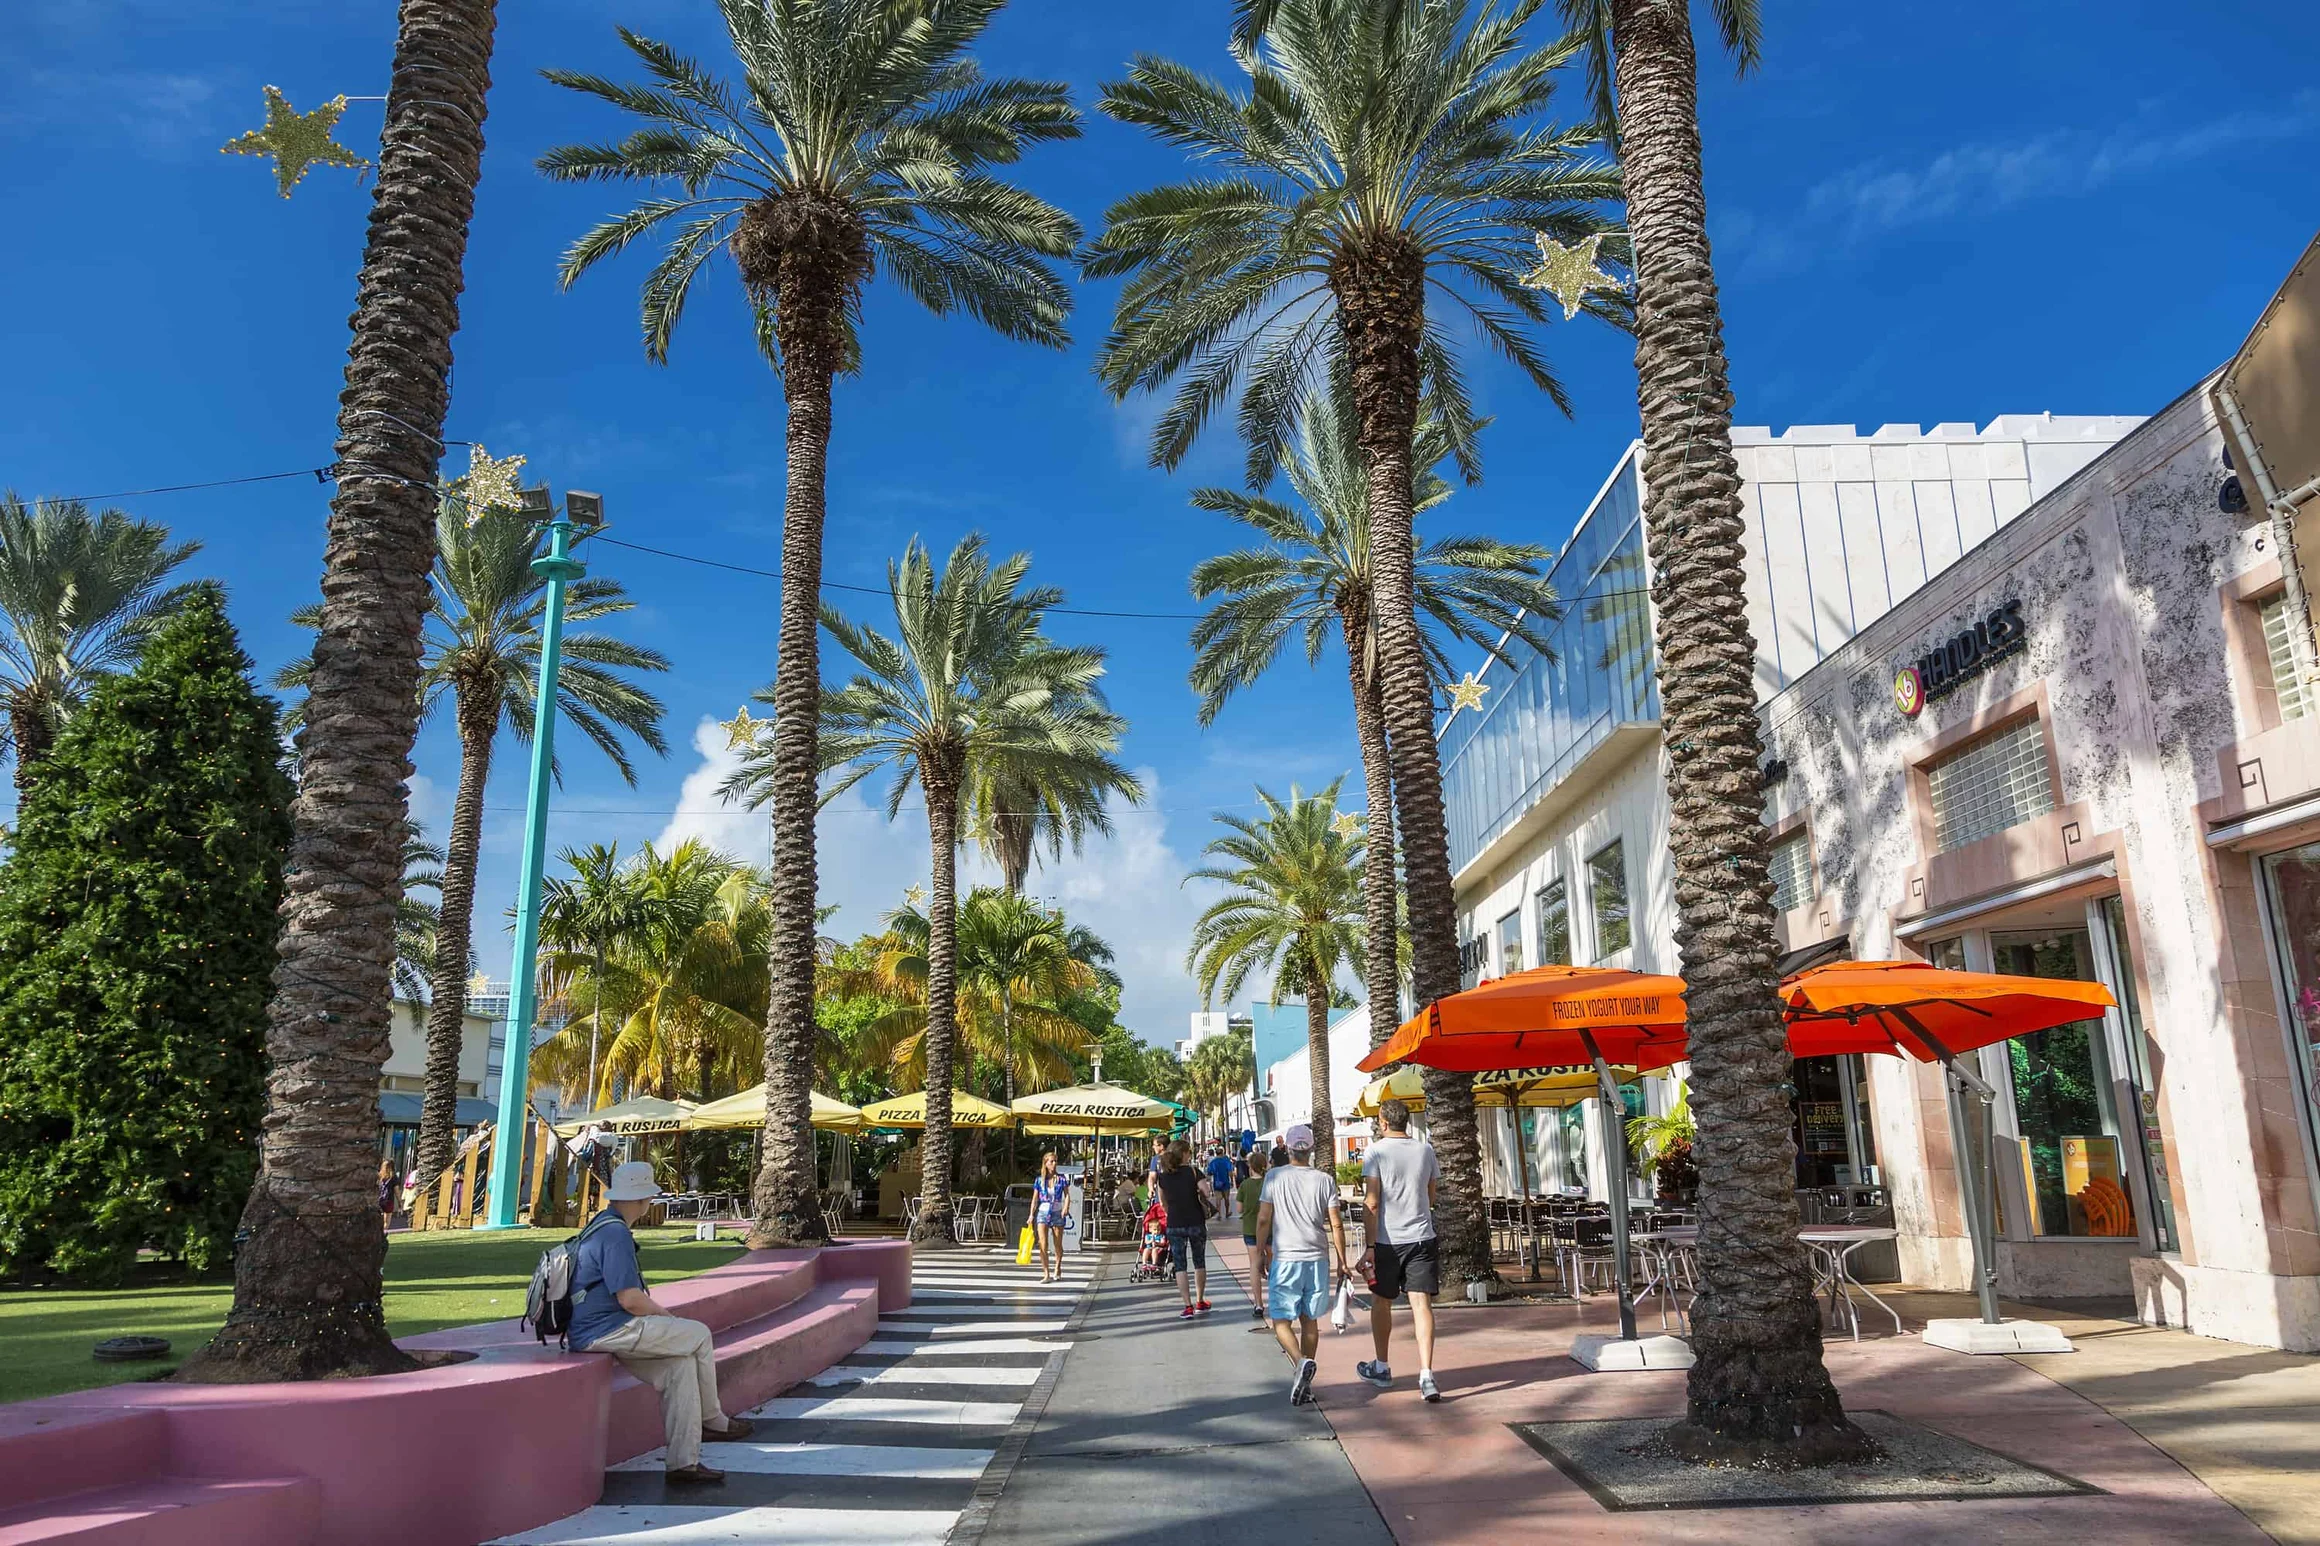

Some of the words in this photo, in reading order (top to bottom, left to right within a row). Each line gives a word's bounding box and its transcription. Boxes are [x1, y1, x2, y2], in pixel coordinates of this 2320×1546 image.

[1896, 673, 1915, 708] 16
[1916, 599, 2025, 691] HANDLES
[1552, 1000, 1586, 1020] FROZEN
[1587, 998, 1619, 1018] YOGURT
[1619, 997, 1641, 1017] YOUR
[1643, 996, 1661, 1015] WAY
[879, 1109, 920, 1120] PIZZA
[952, 1111, 987, 1123] TICA
[1040, 1103, 1081, 1114] PIZZA
[1084, 1105, 1146, 1117] RUSTICA
[621, 1119, 681, 1133] RUSTICA
